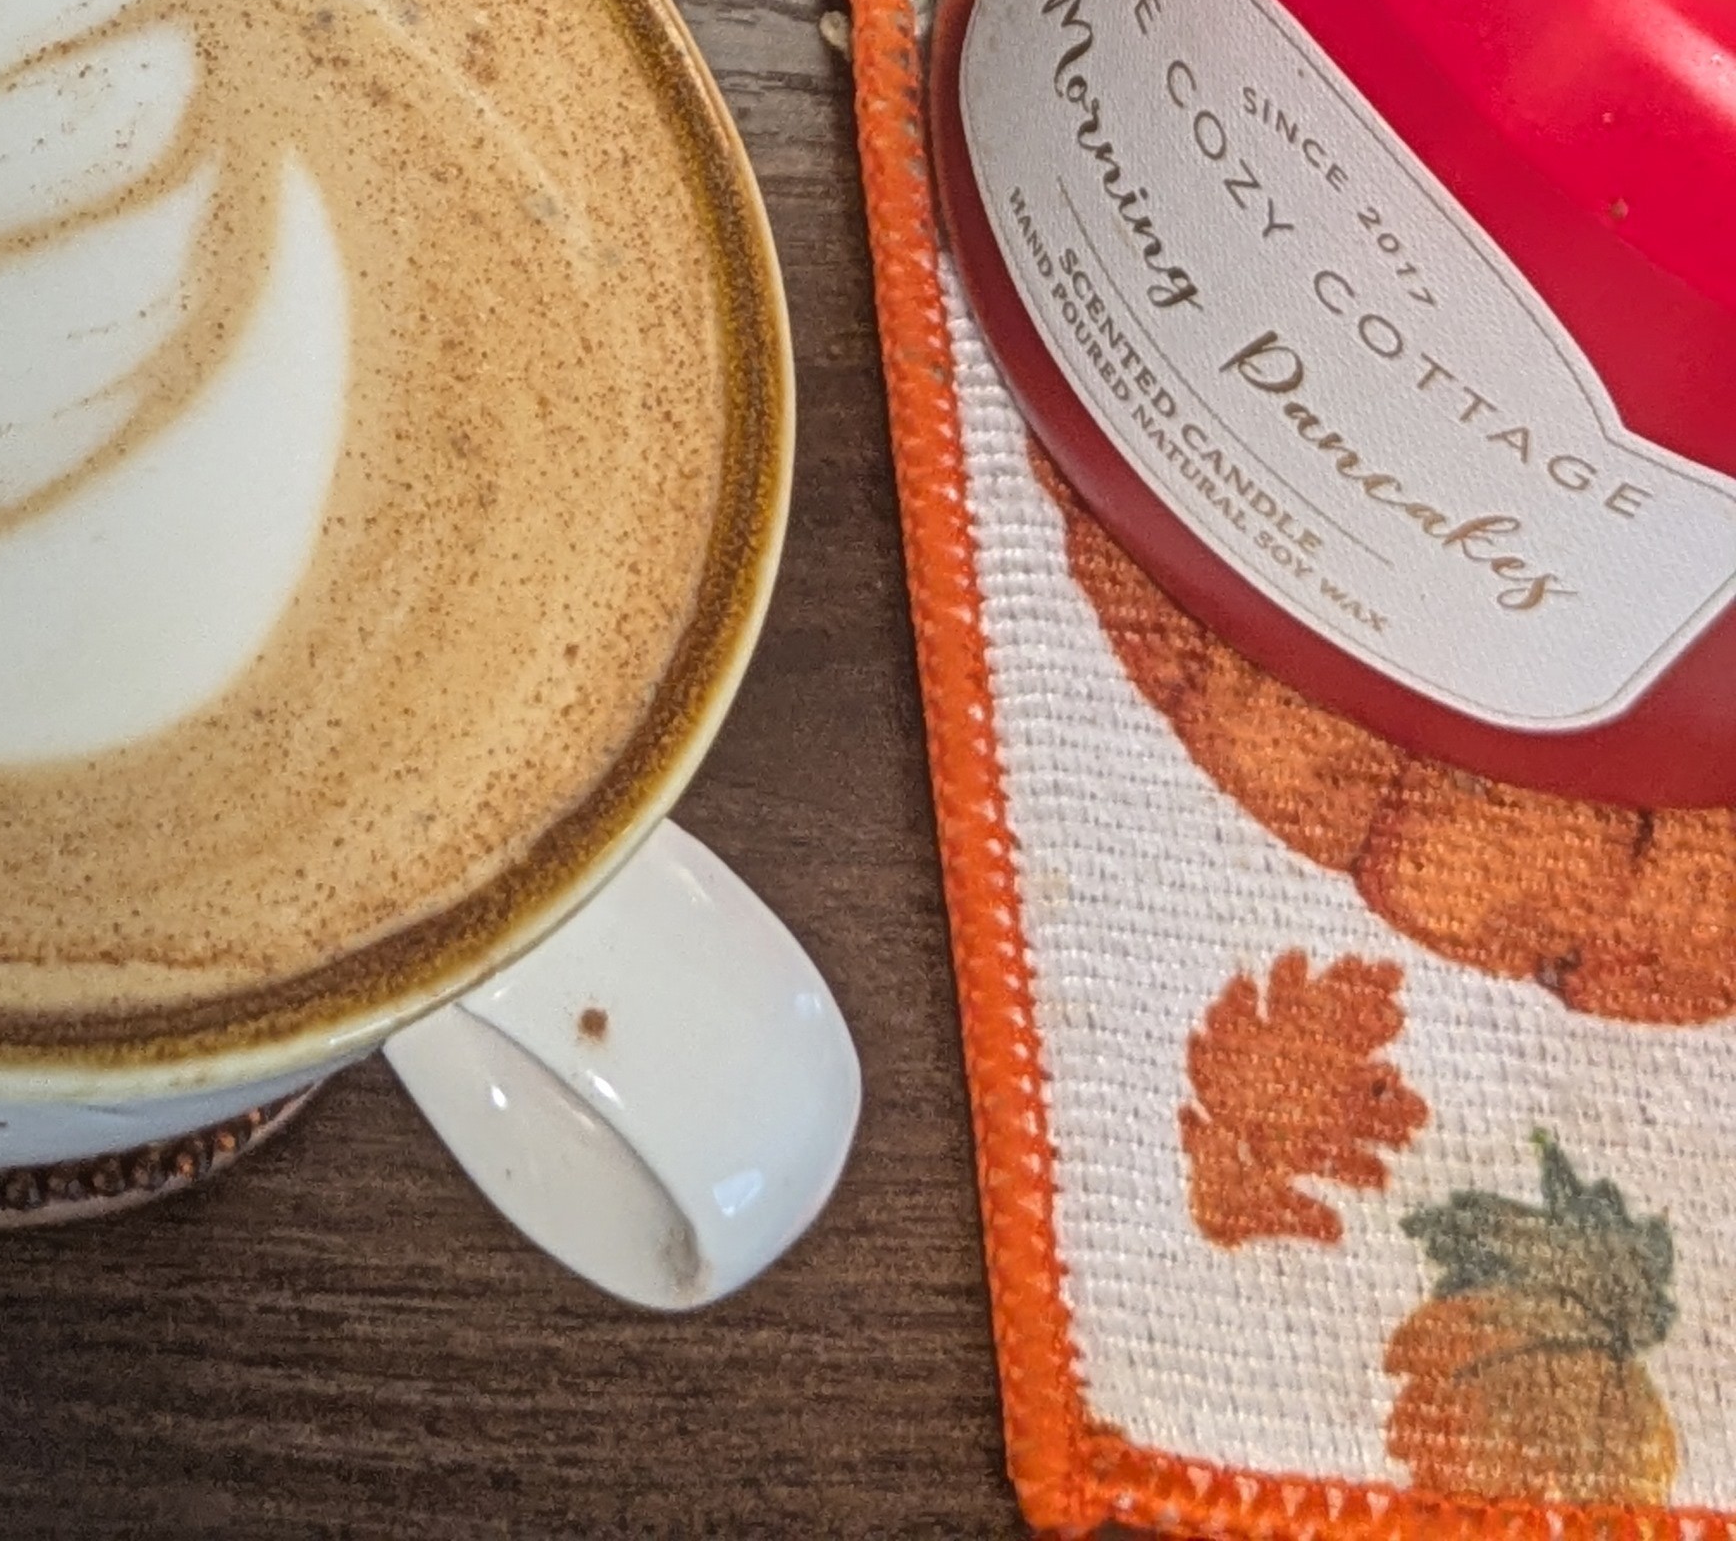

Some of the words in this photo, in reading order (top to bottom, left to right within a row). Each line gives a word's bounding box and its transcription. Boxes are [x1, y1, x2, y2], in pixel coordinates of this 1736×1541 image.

[1166, 59, 1296, 239] COZY
[1312, 268, 1655, 519] COTTAGE
[1241, 85, 1351, 194] SINCE
[1356, 206, 1439, 310] 2017
[1008, 186, 1055, 281] HAND
[1050, 281, 1132, 404] POURED
[1130, 402, 1250, 534] NATURAL
[1318, 576, 1390, 634] WAX
[1058, 246, 1178, 420] SCENTED
[1180, 422, 1326, 555] CANDLE
[1219, 329, 1579, 612] Pancakes
